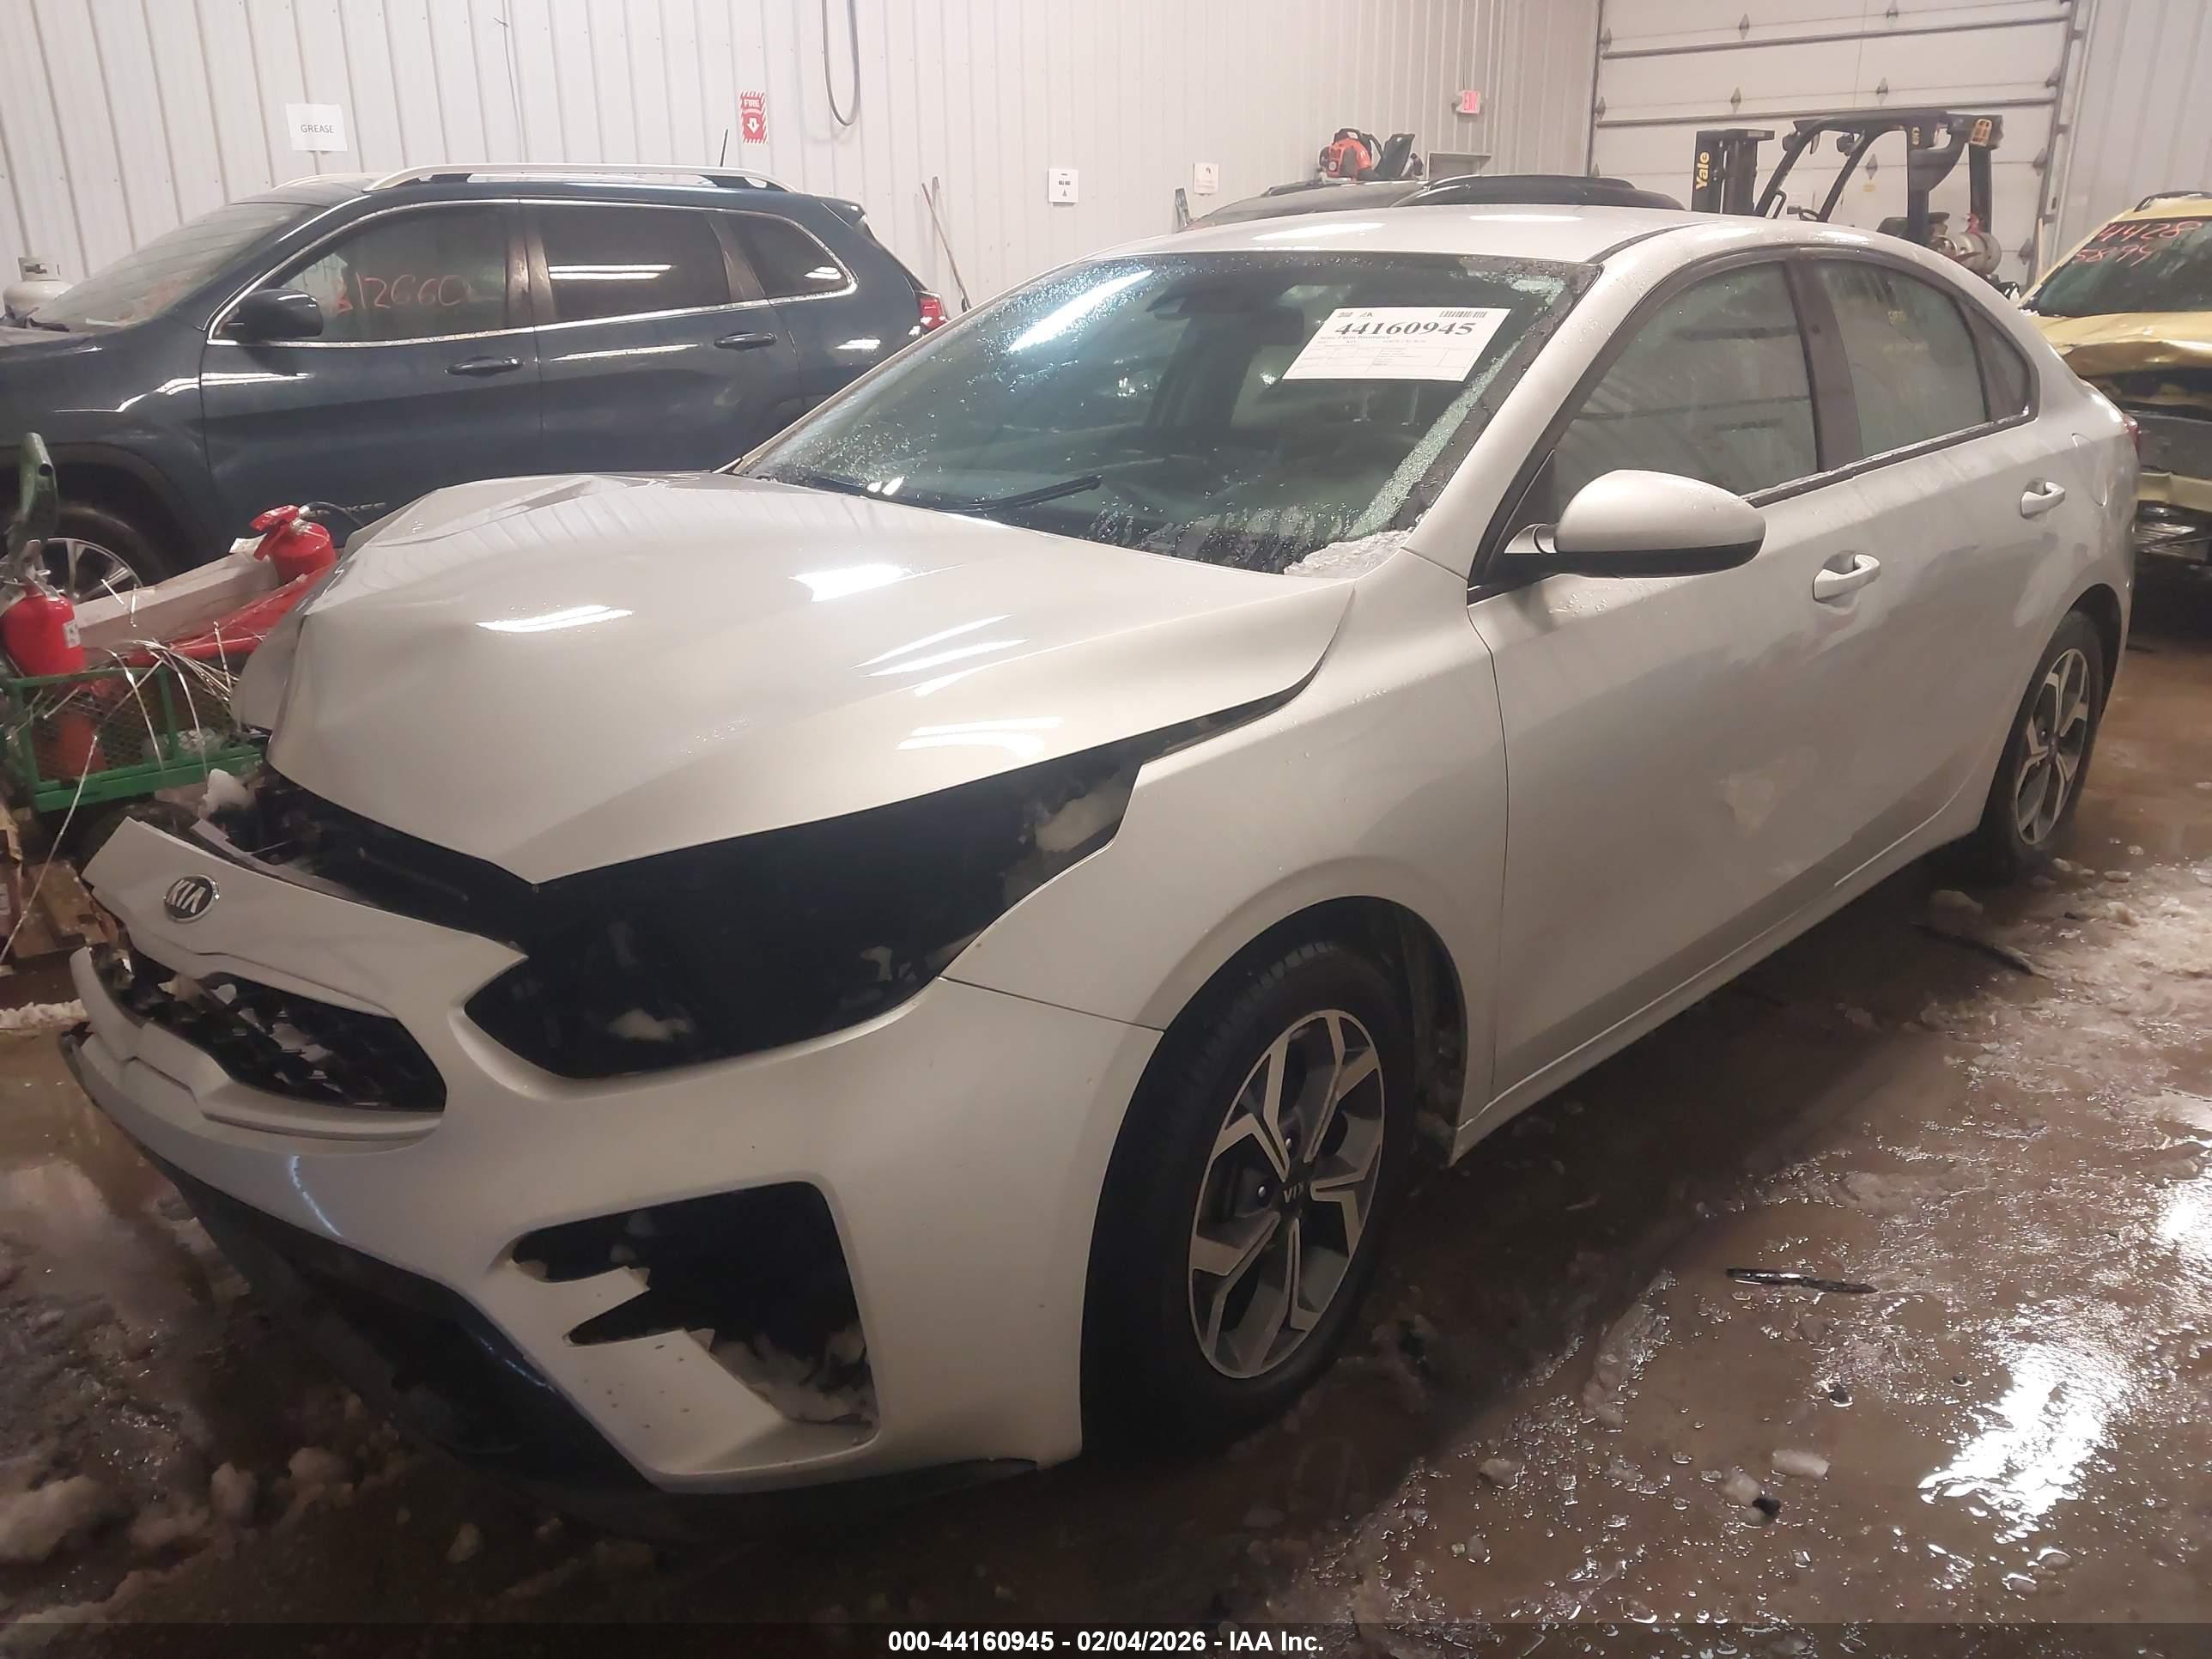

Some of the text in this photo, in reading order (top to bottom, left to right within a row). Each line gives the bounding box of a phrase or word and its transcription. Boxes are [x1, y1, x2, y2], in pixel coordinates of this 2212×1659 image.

[744, 99, 760, 107] FIRE
[301, 125, 335, 133] GREASE
[1696, 151, 1710, 190] Yale
[1334, 322, 1477, 336] 44160945
[166, 878, 207, 914] KIA
